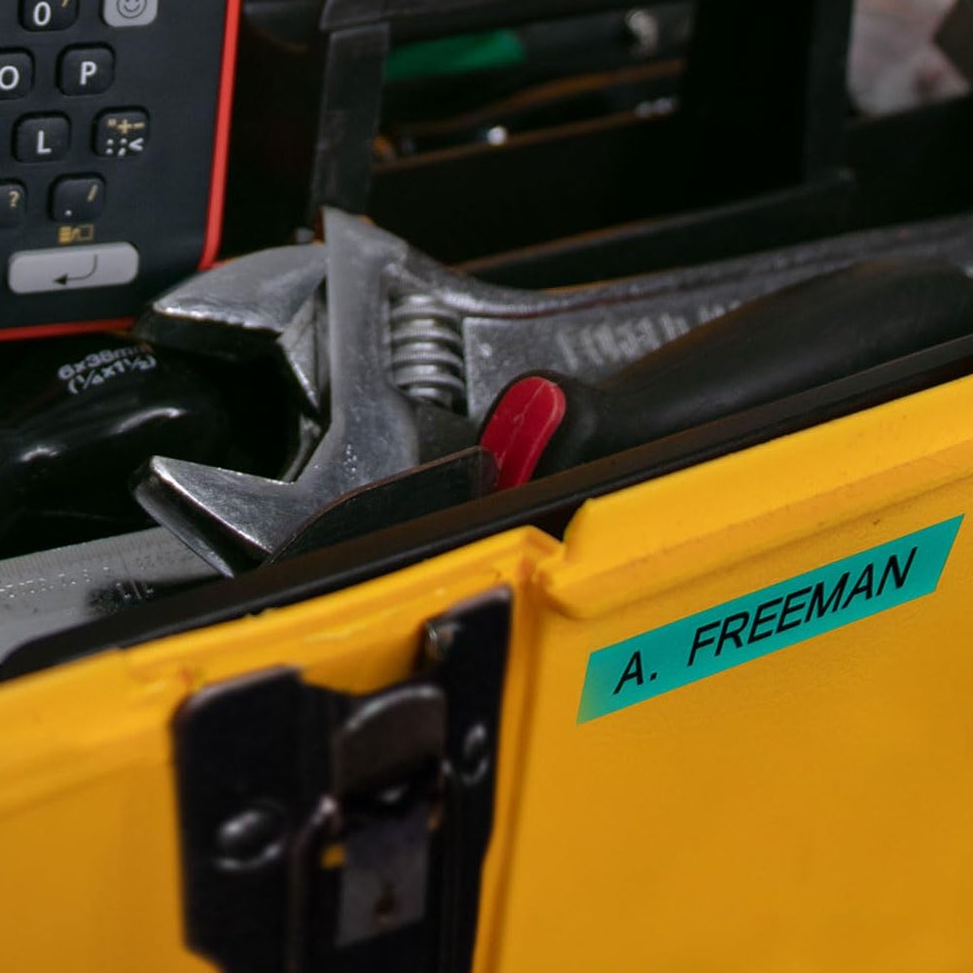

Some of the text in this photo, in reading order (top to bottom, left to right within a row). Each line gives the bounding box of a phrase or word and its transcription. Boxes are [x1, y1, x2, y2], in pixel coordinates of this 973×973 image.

[33, 1, 51, 26] 0
[80, 60, 97, 85] P
[37, 130, 52, 154] L
[9, 190, 20, 207] ?
[87, 184, 99, 202] /
[612, 546, 918, 696] A. FREEMAN
